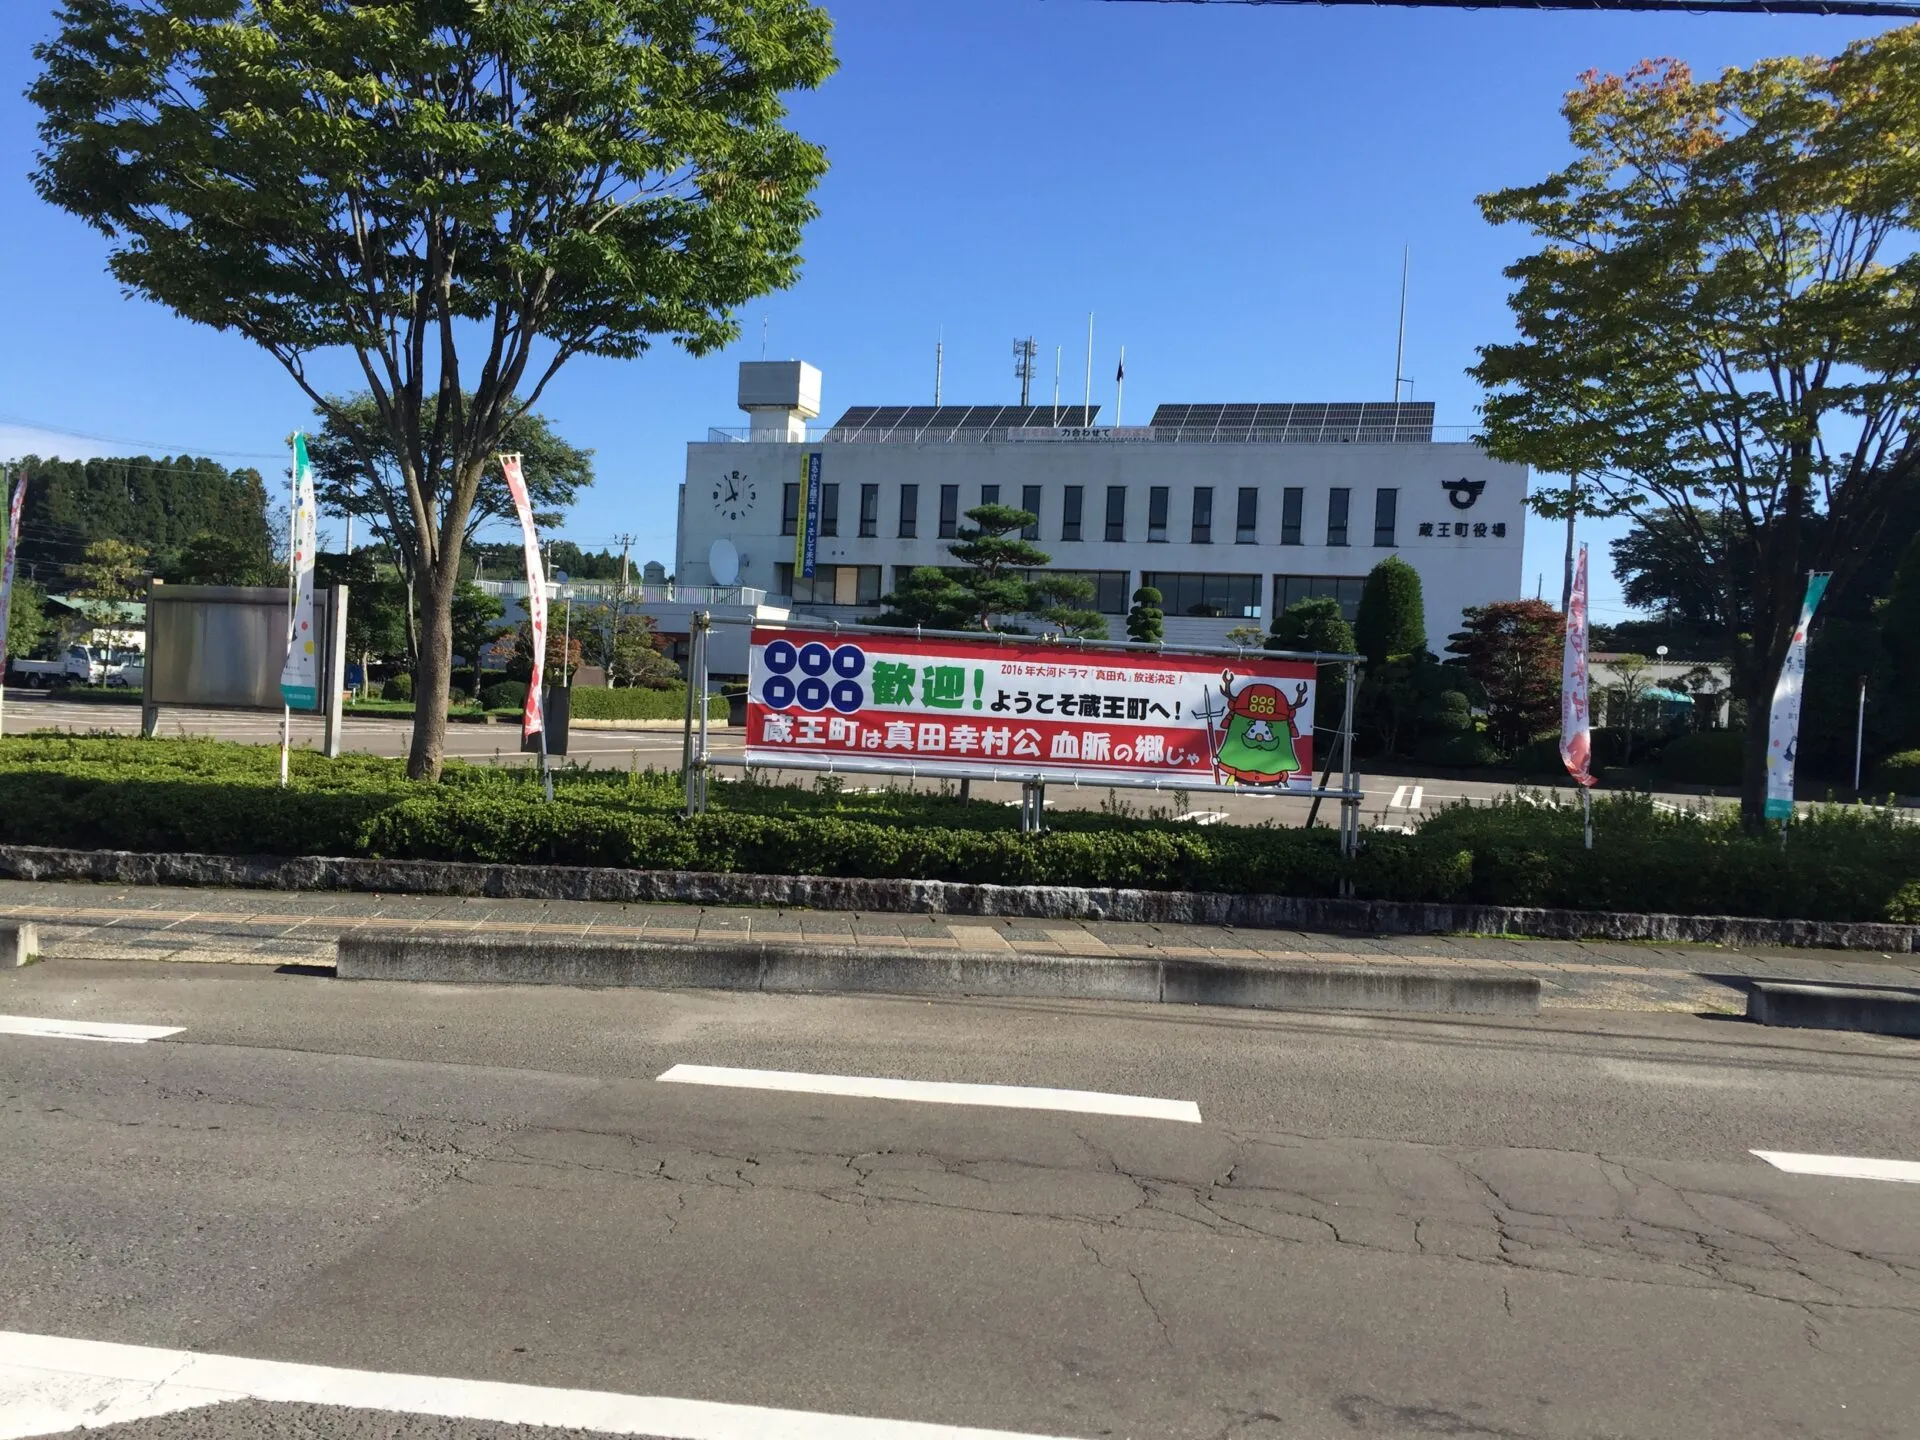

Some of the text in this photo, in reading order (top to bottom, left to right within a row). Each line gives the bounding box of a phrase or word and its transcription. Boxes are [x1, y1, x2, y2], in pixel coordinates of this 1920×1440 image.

[731, 470, 740, 480] 12
[712, 491, 719, 500] 9
[750, 491, 756, 500] 3
[730, 512, 737, 520] 6
[1418, 522, 1506, 538] 蔵王町役場
[871, 659, 985, 711] 歓迎！
[990, 689, 1181, 722] ようこそ蔵王町へ！
[1050, 729, 1200, 766] 血脈の郷じゃ
